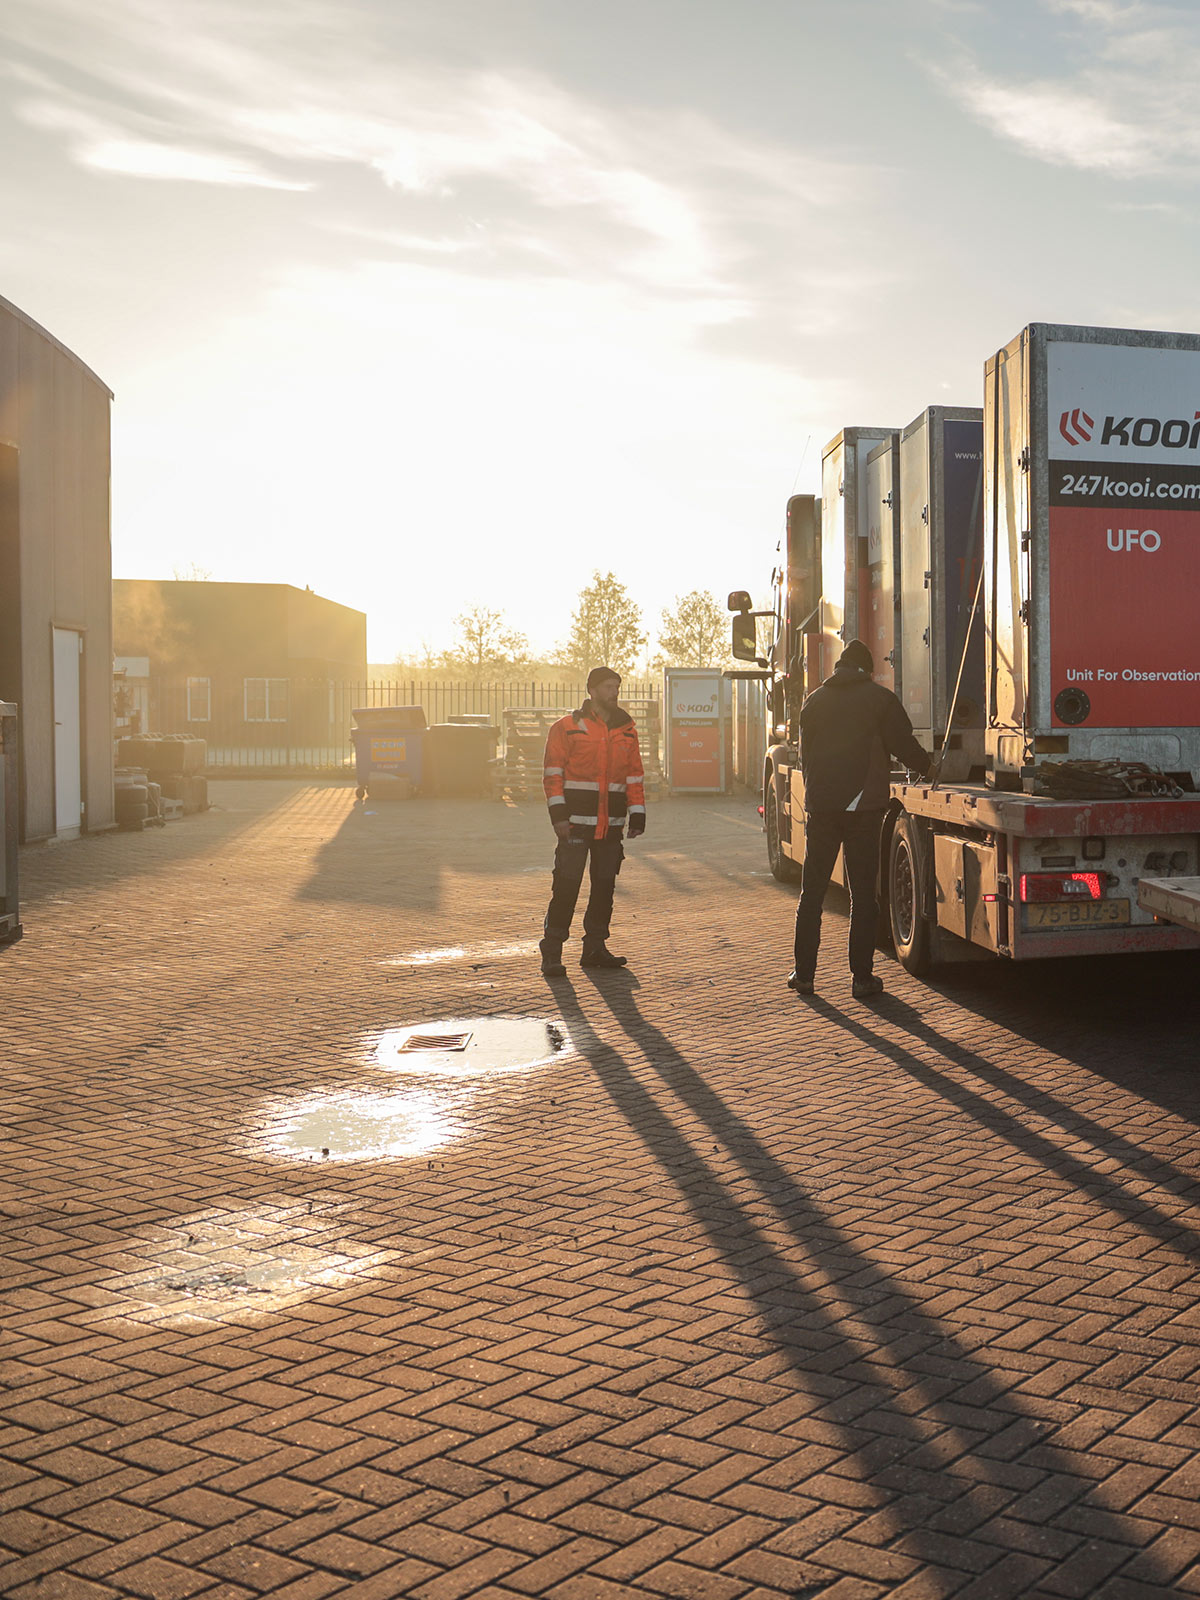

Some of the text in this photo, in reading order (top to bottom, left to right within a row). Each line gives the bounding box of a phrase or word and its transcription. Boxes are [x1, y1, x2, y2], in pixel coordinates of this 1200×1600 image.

[1106, 529, 1161, 552] UFO
[1066, 669, 1094, 681] Unit
[1097, 669, 1118, 681] For
